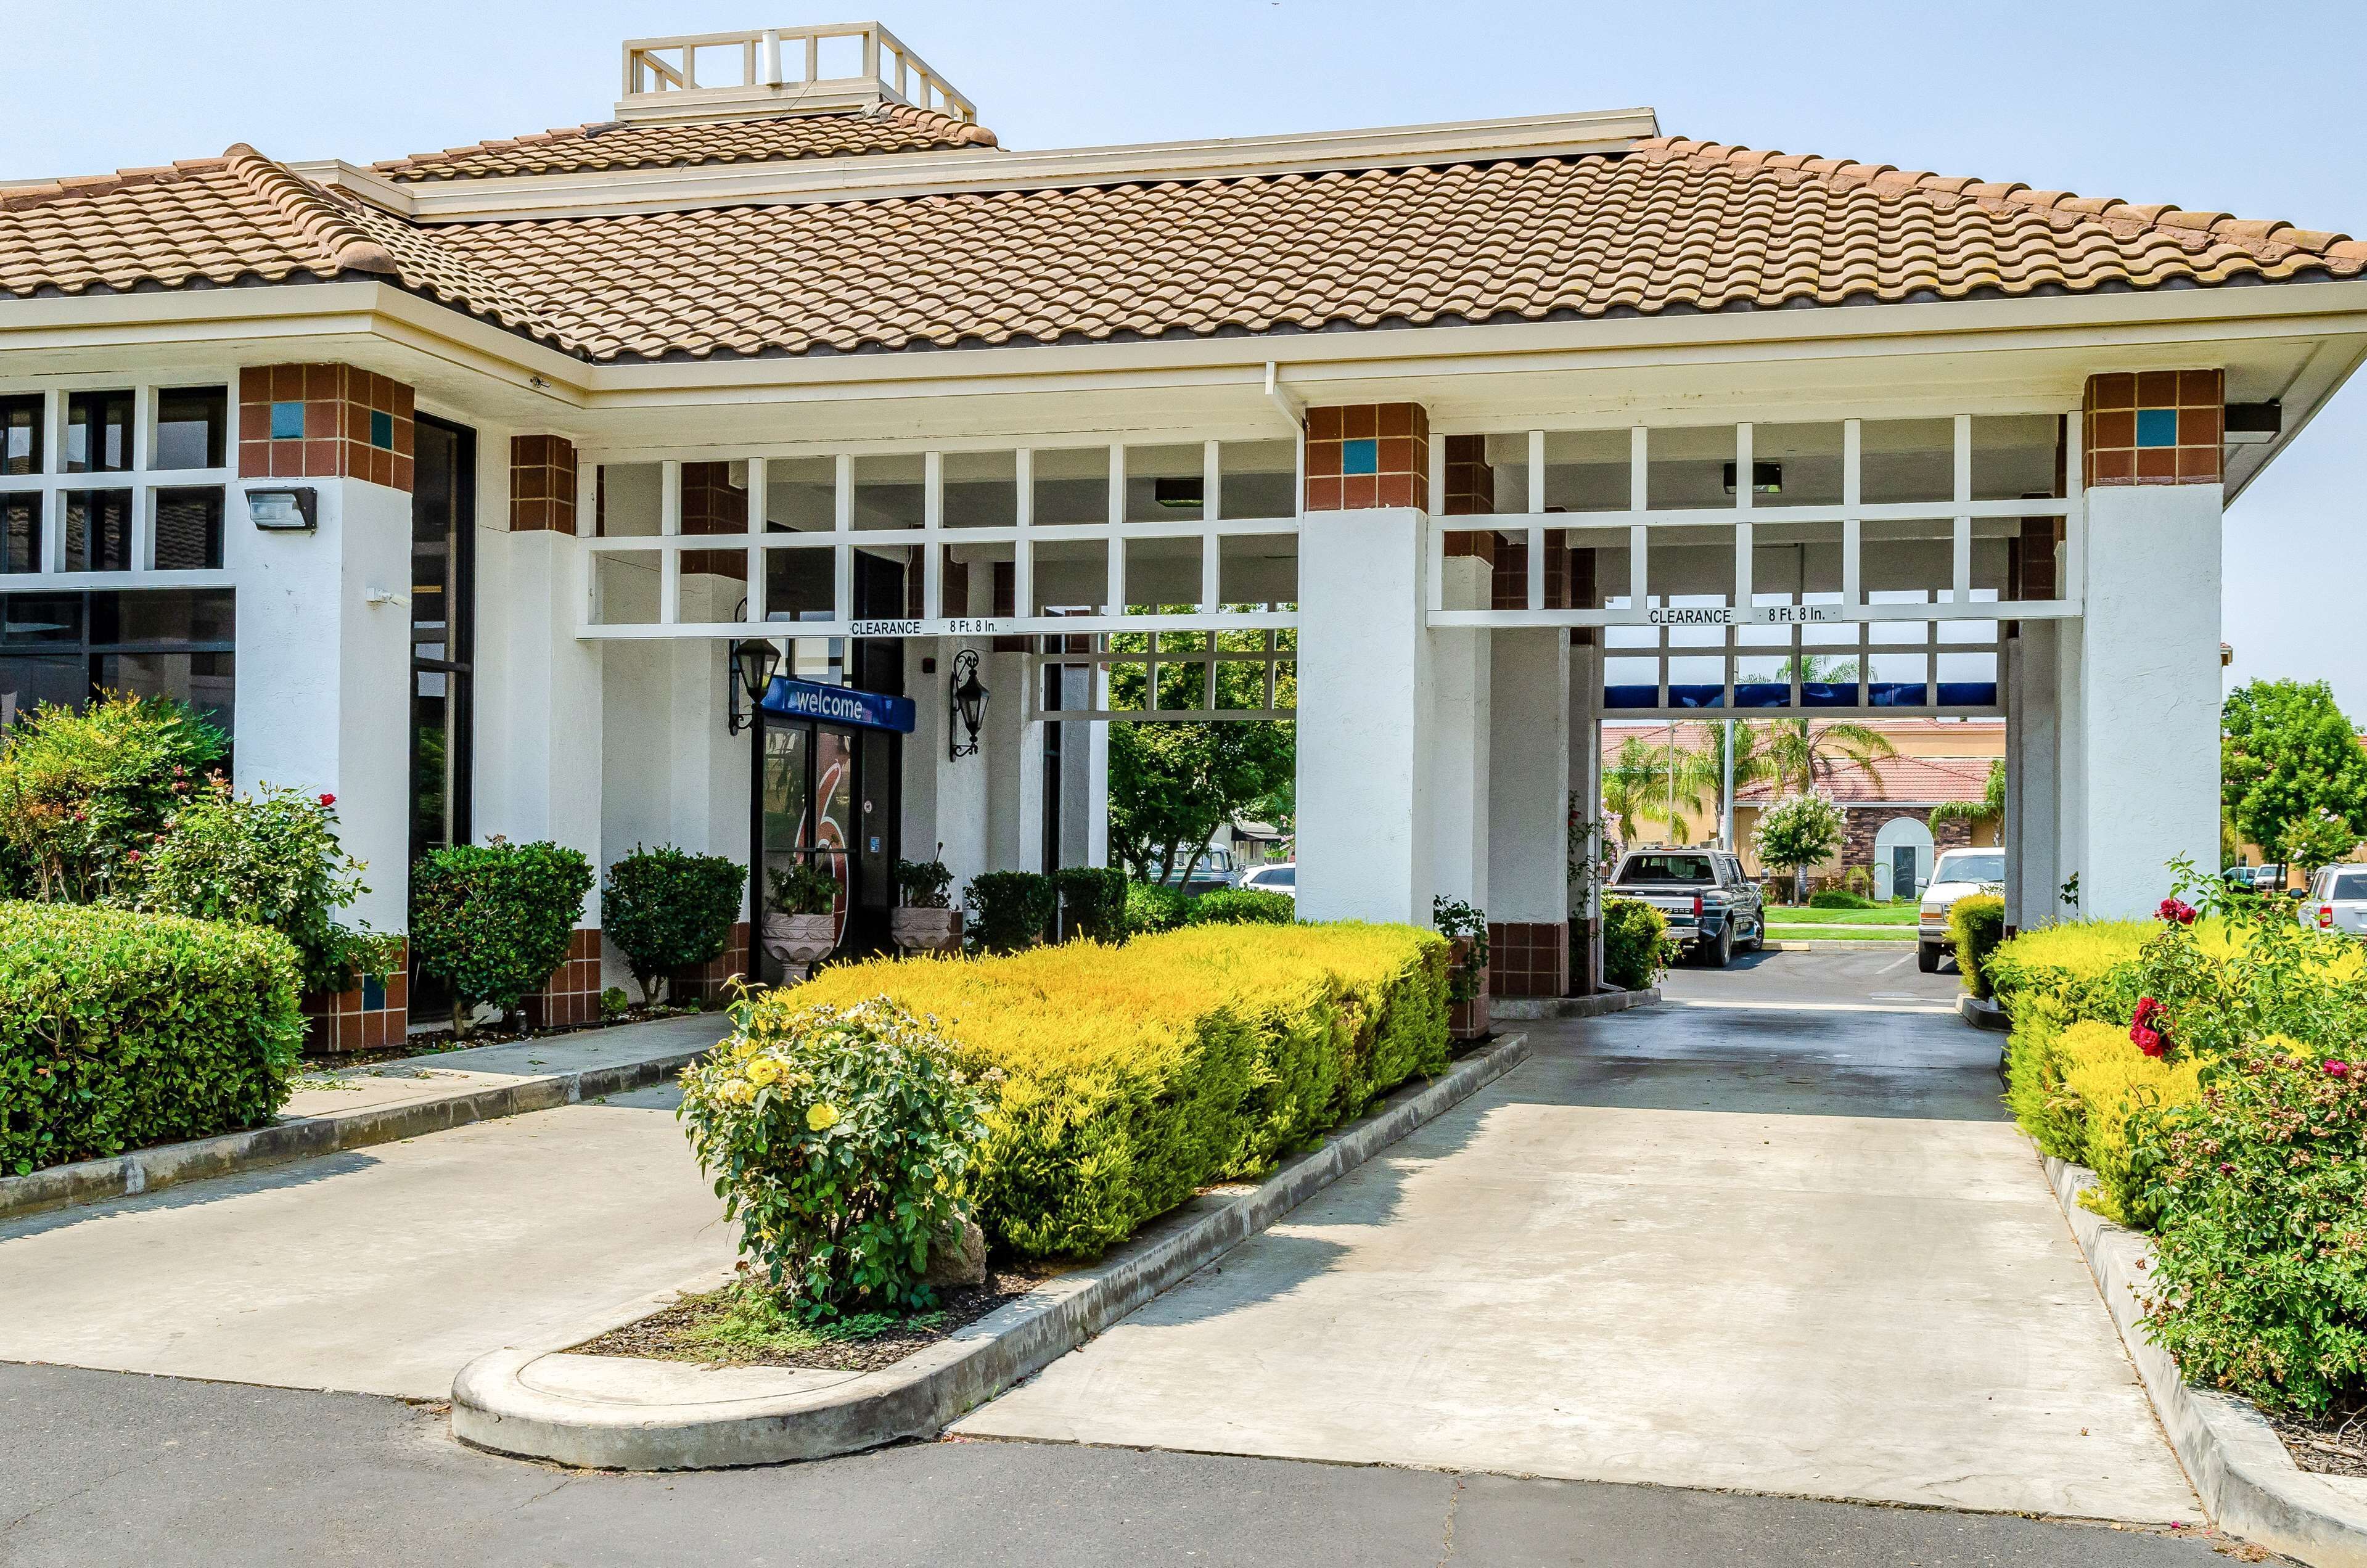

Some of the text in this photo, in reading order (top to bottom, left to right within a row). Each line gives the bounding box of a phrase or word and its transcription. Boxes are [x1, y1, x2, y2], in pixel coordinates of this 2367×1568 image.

[1649, 609, 1731, 623] CLEARANCE
[1768, 607, 1825, 622] 8 Ft. 8 In.
[851, 622, 920, 635] CLEARANCE
[950, 620, 998, 633] 8 Ft. 8 In.
[797, 688, 863, 720] welcome
